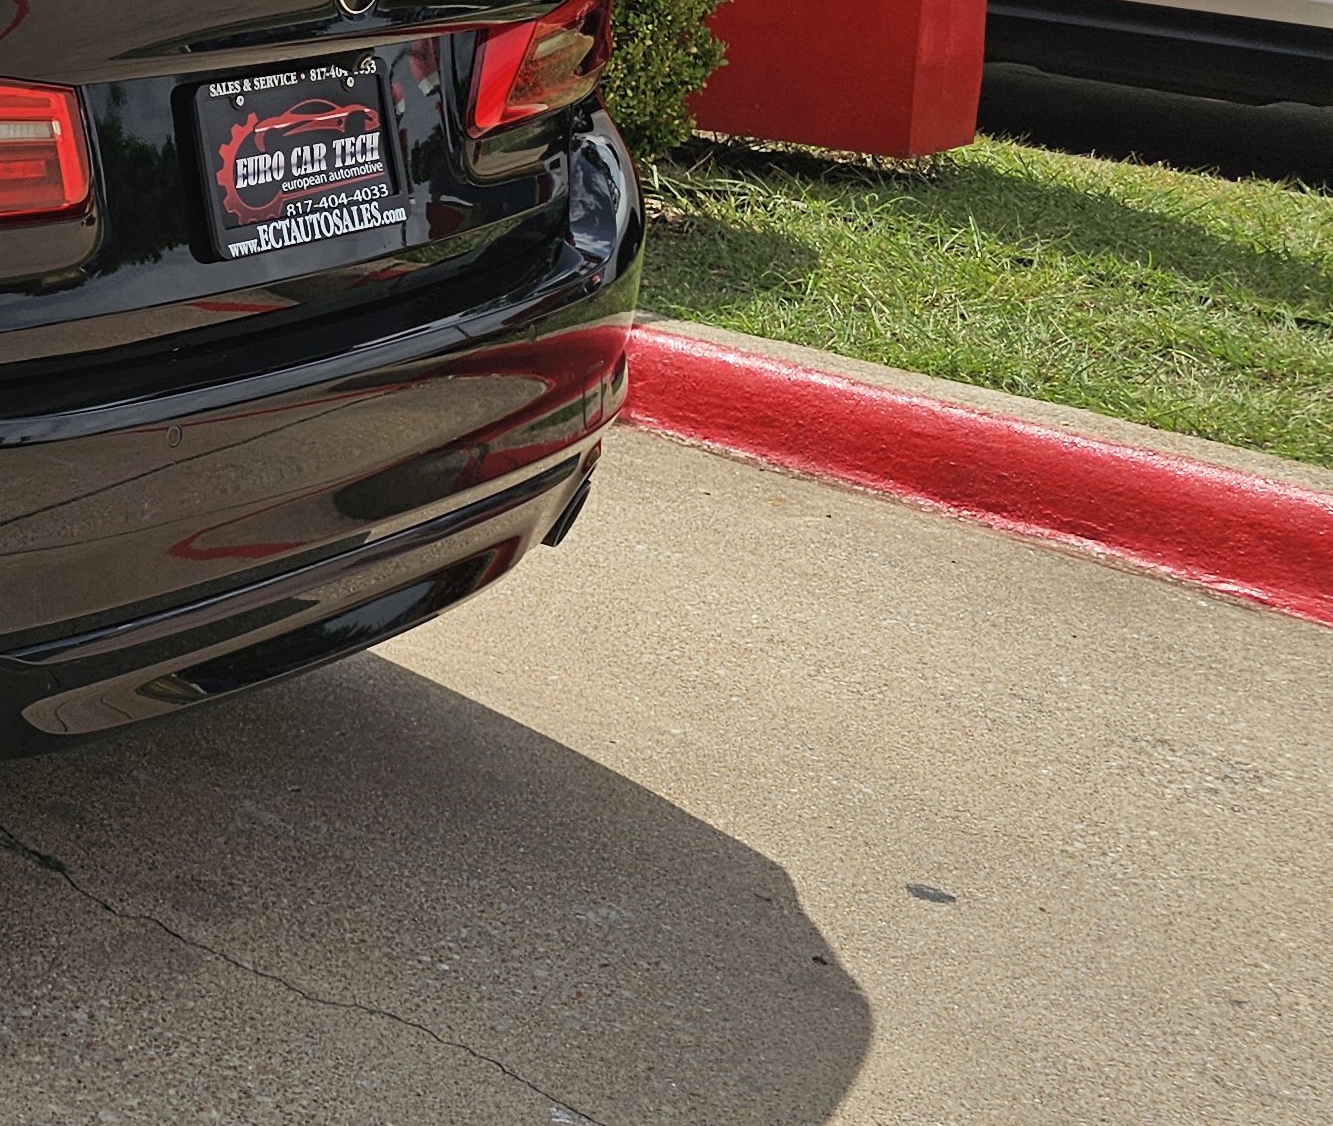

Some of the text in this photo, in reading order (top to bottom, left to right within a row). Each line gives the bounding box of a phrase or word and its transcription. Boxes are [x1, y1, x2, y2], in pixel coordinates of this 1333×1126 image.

[209, 80, 241, 97] SALES
[242, 78, 252, 92] &
[253, 71, 298, 91] SERVICE
[235, 132, 381, 189] EURO CAR TECH
[281, 160, 384, 192] european automotive
[286, 183, 389, 216] 817-404-4033
[227, 200, 408, 258] www.ECTAUTOSALES.com
